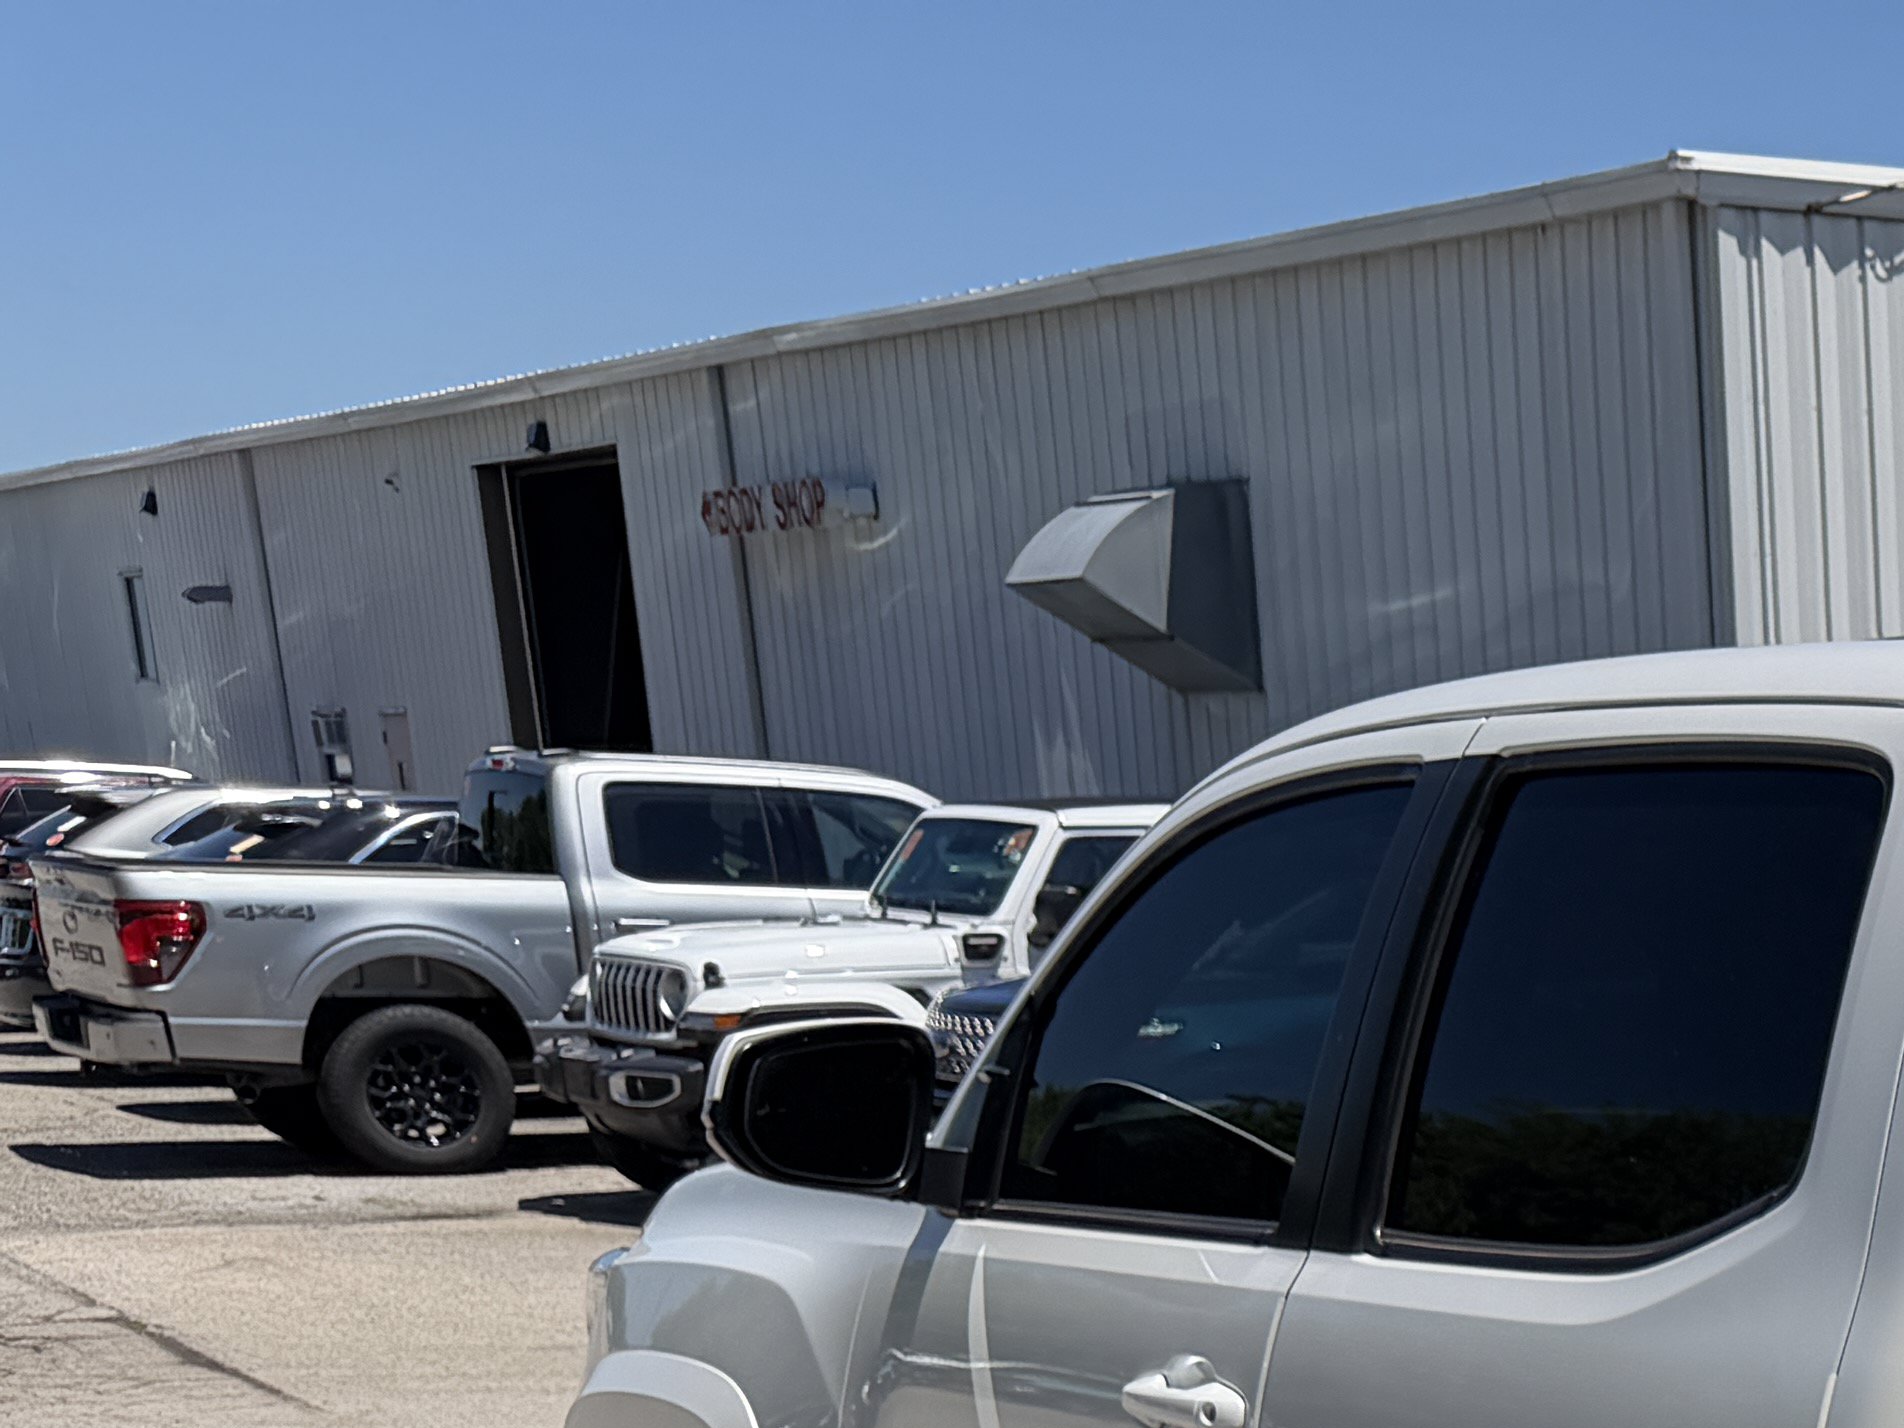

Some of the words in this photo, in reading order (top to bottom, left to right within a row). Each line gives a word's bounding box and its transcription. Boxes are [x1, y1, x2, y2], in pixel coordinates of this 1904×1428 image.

[713, 485, 765, 535] BODY
[772, 477, 825, 531] SHOP
[52, 937, 106, 967] F-150
